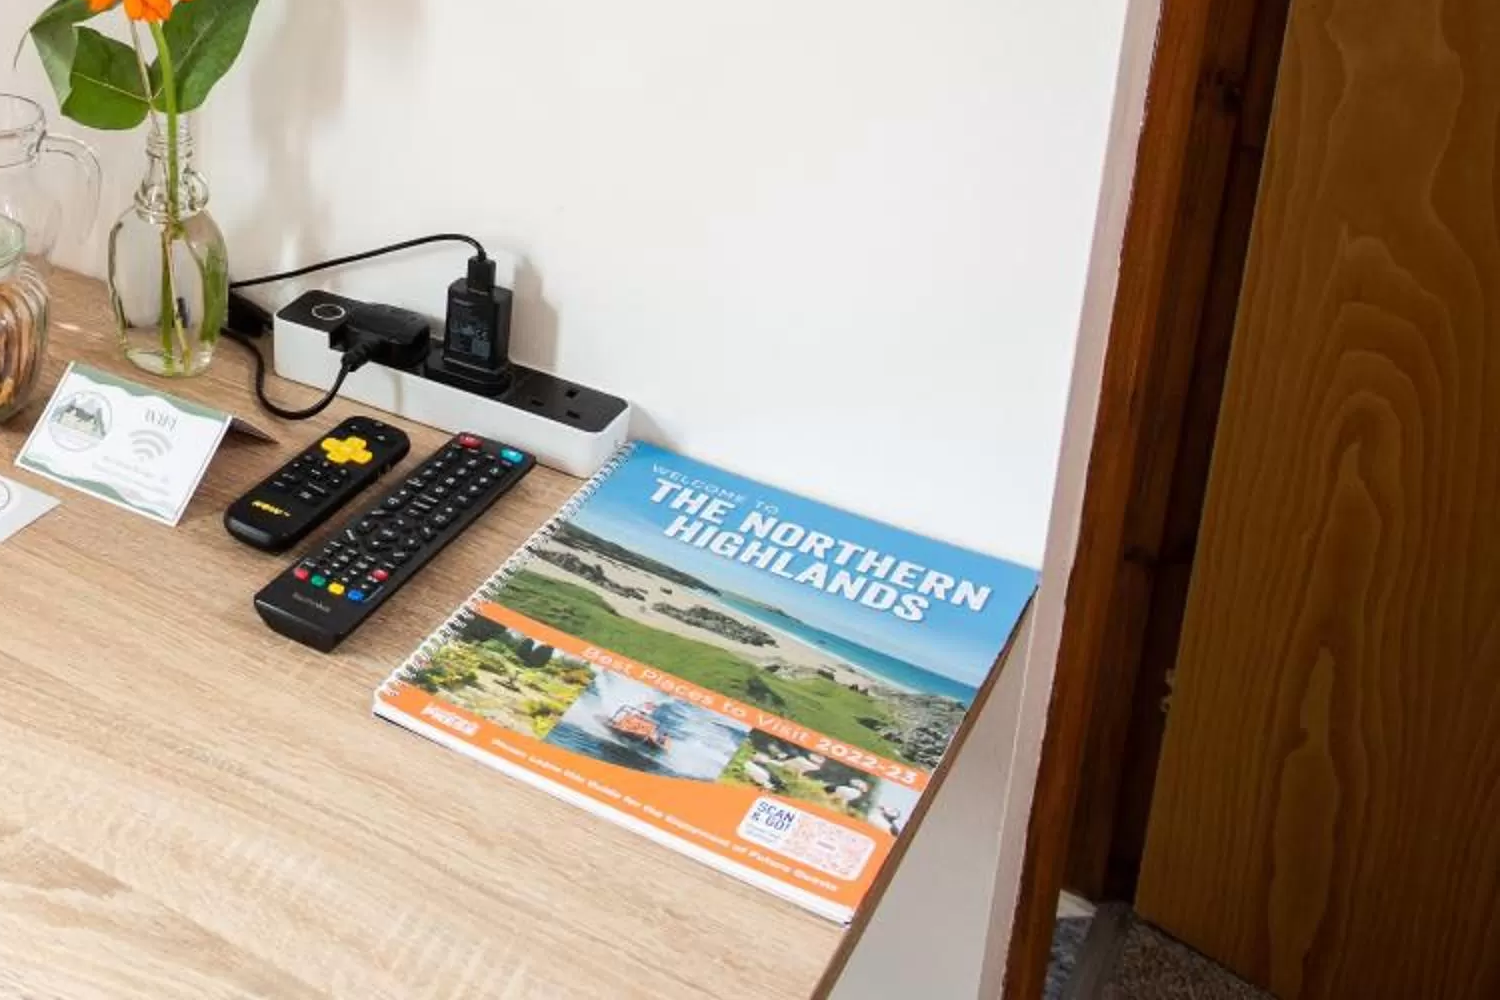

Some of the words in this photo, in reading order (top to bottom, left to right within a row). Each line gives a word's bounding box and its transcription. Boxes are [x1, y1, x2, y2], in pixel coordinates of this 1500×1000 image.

[652, 463, 746, 503] WELCOME
[753, 499, 780, 515] TO
[650, 477, 737, 525] THE
[739, 511, 993, 612] NORTHERN
[663, 514, 930, 623] HIGHLANDS
[581, 646, 632, 675] Best
[639, 669, 715, 707] Places
[722, 700, 748, 719] to
[756, 712, 810, 743] Visit
[815, 739, 919, 785] 2022-23
[756, 801, 797, 823] SCAN
[764, 817, 791, 832] GO!
